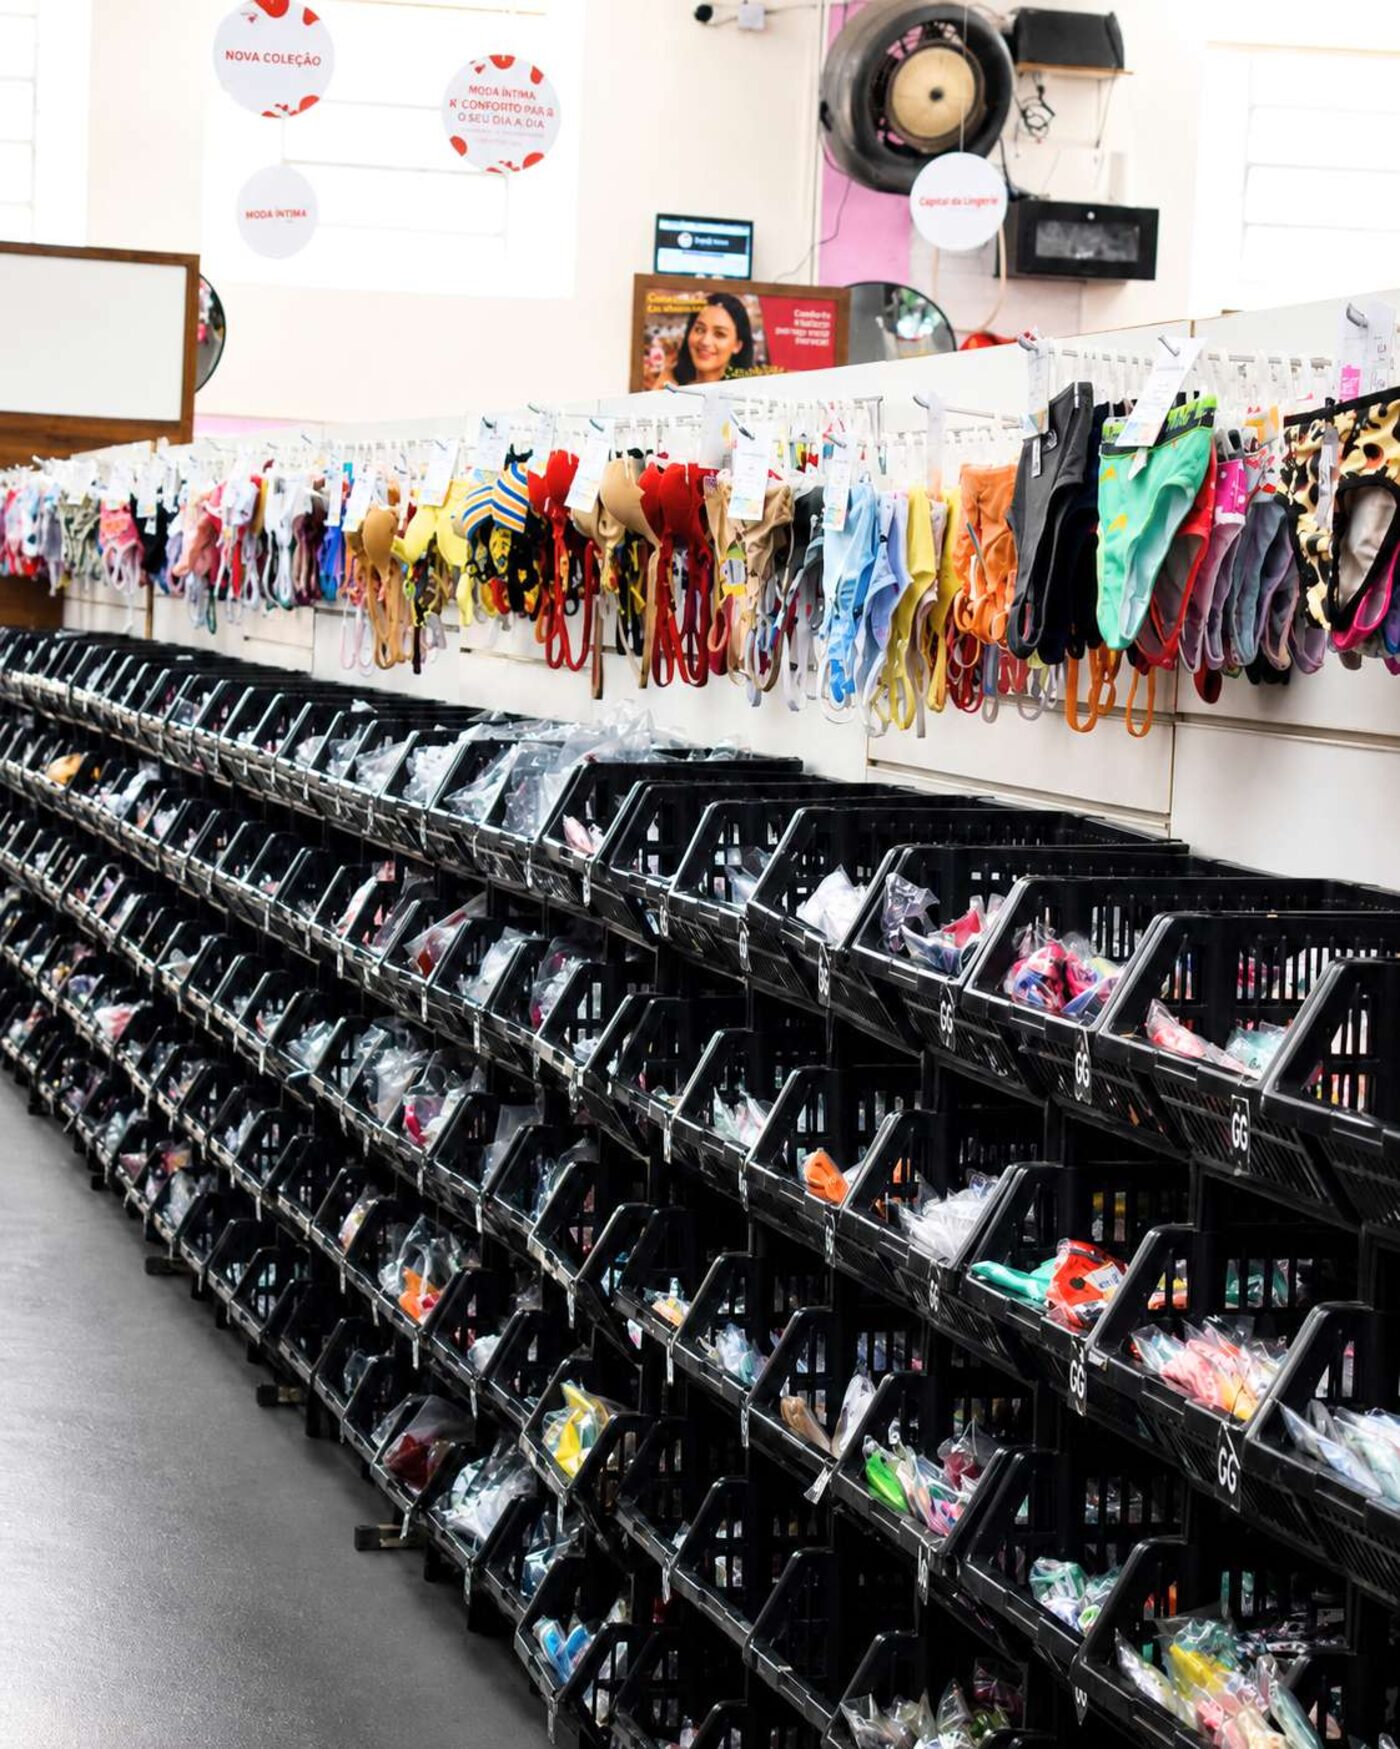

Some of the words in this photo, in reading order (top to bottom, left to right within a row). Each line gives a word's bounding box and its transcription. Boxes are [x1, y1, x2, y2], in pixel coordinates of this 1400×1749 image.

[225, 50, 260, 62] NOVA
[263, 51, 322, 68] COLEÇÃO
[468, 85, 499, 97] MODA
[461, 99, 522, 114] CONFORTO
[457, 112, 466, 122] O
[468, 113, 490, 124] SEU
[492, 115, 514, 126] DIA
[525, 118, 545, 129] DIA
[919, 195, 949, 208] Capital
[951, 196, 962, 206] da
[963, 196, 999, 208] Lingerie
[245, 209, 273, 220] MODA
[940, 1000, 954, 1034] GG
[1075, 1051, 1091, 1088] GG
[1231, 1112, 1249, 1151] GG
[1069, 1359, 1086, 1399] GG
[1217, 1446, 1238, 1494] GG
